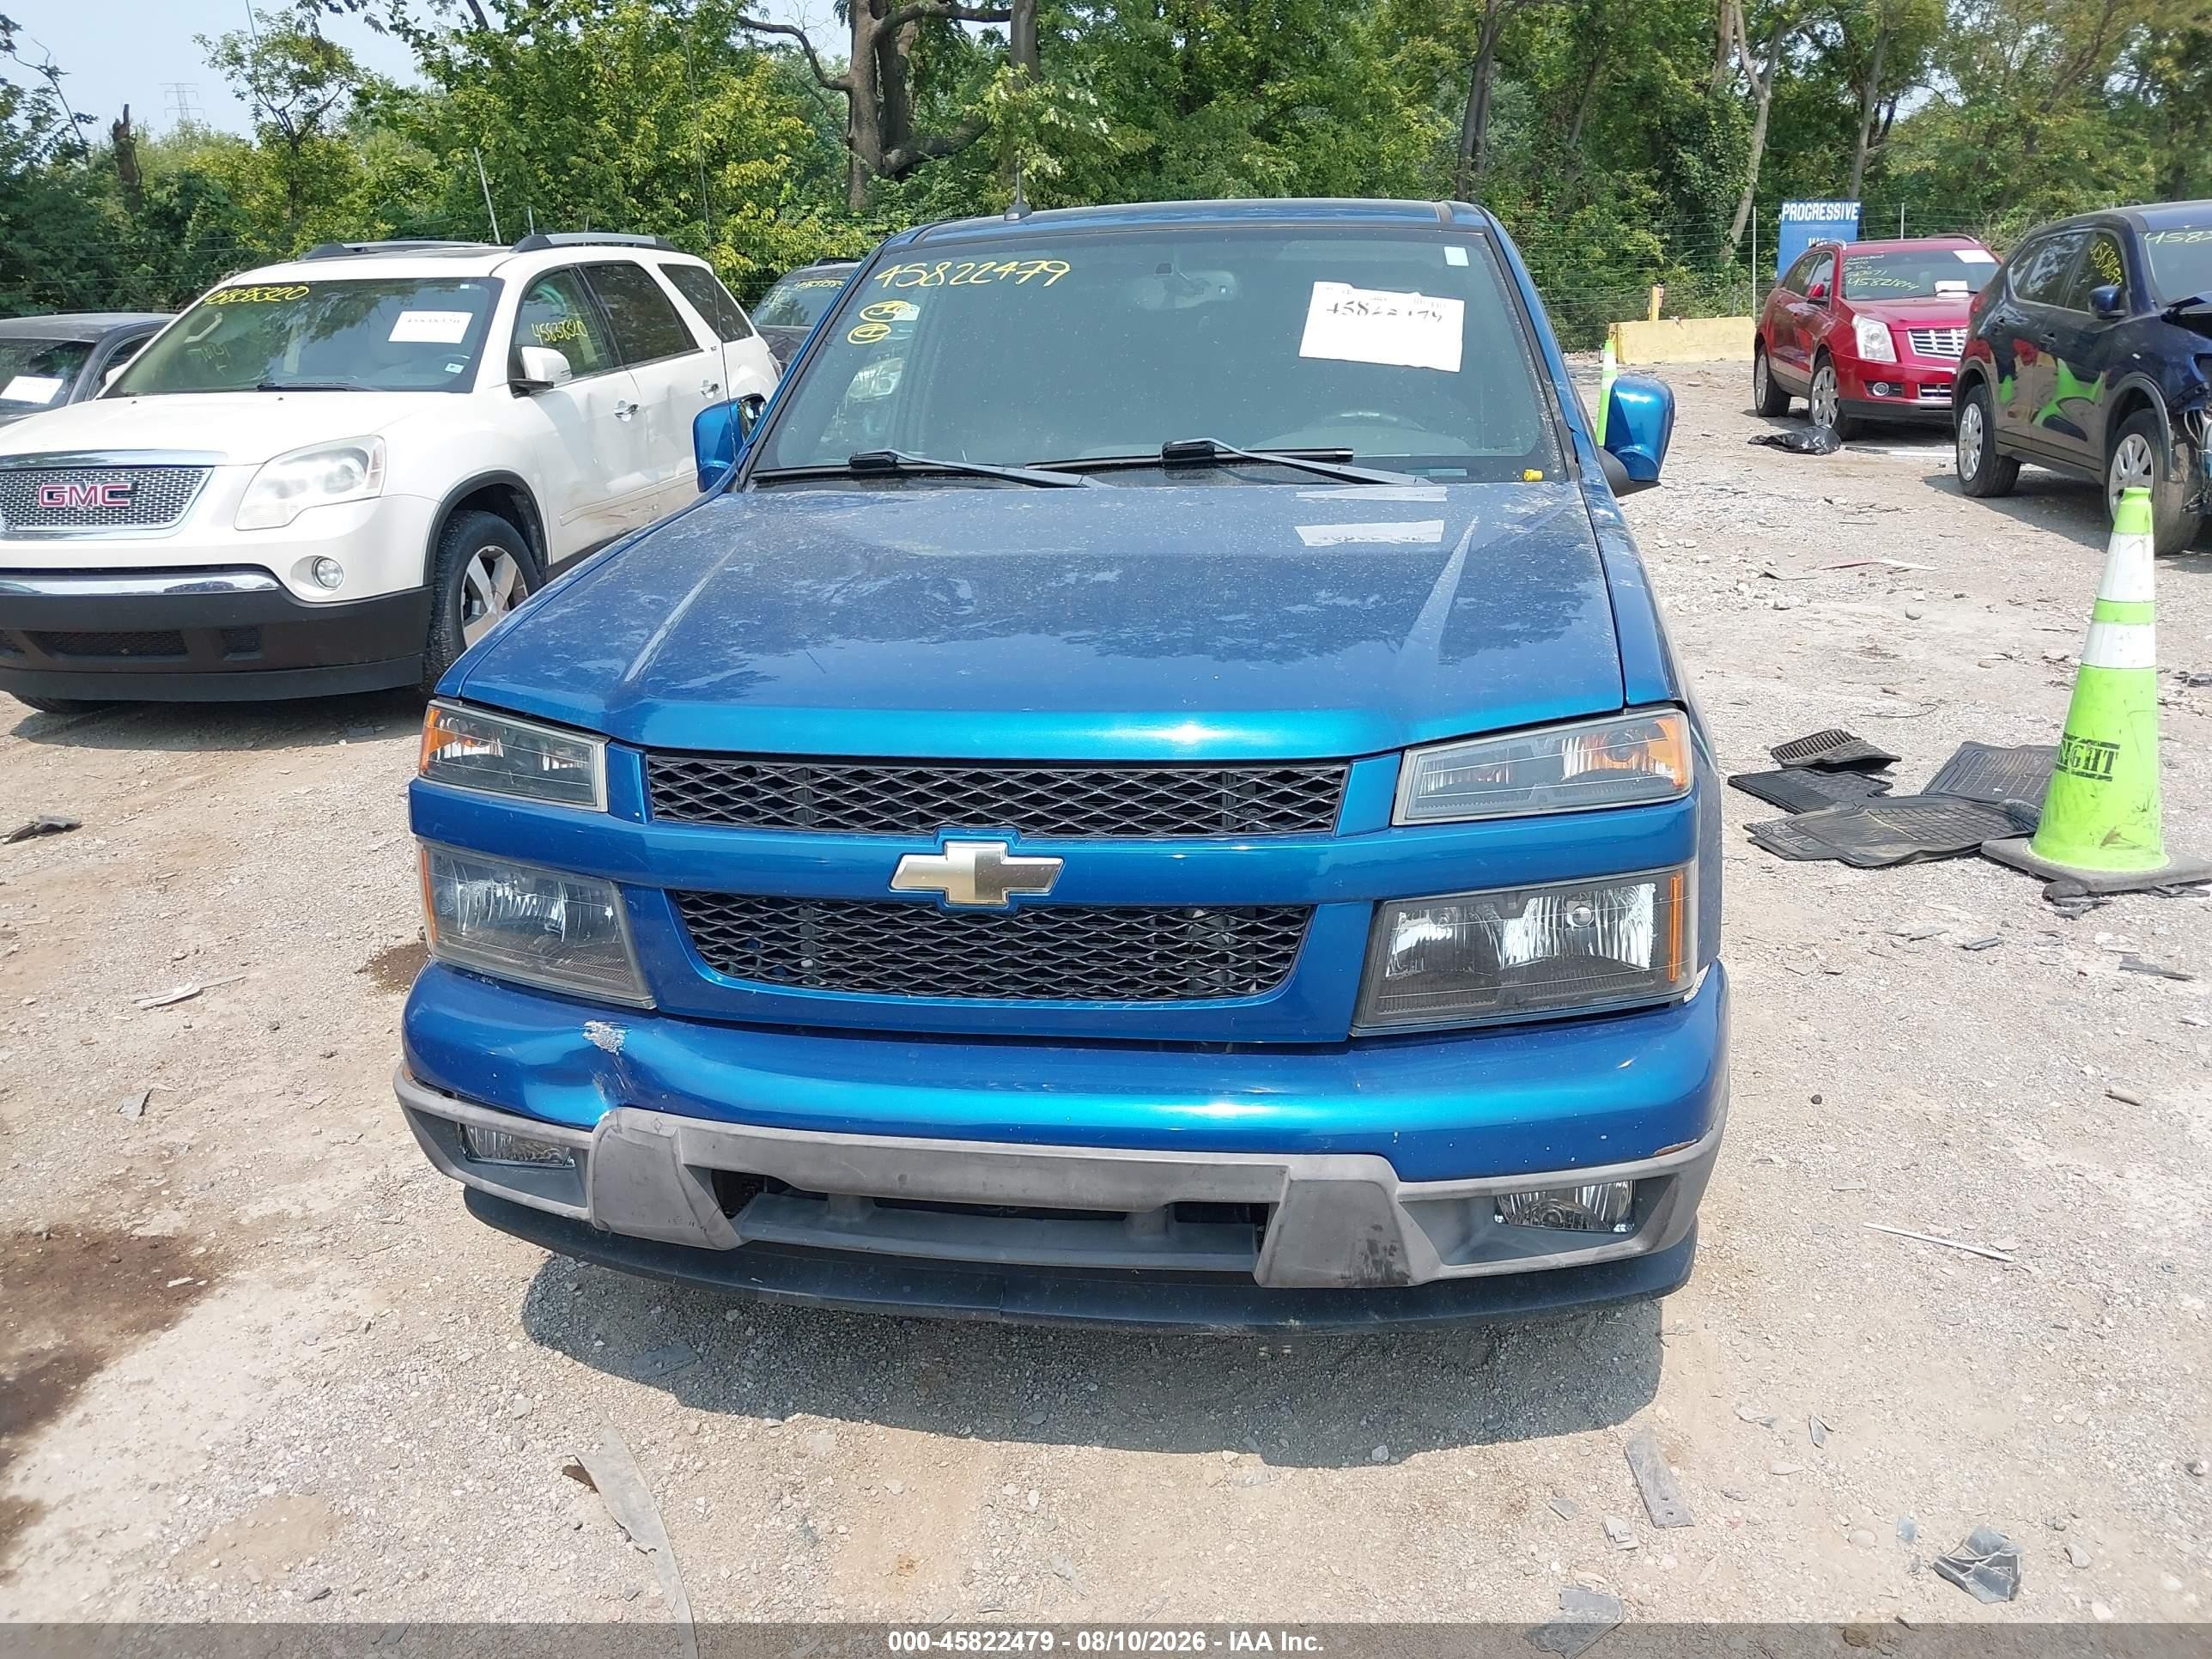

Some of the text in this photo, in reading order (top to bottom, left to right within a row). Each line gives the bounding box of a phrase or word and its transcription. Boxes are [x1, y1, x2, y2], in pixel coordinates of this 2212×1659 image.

[1781, 202, 1861, 222] PROGRESSIVE
[874, 260, 1071, 288] 45822479
[532, 319, 588, 345] 45838320
[39, 483, 132, 507] GMC
